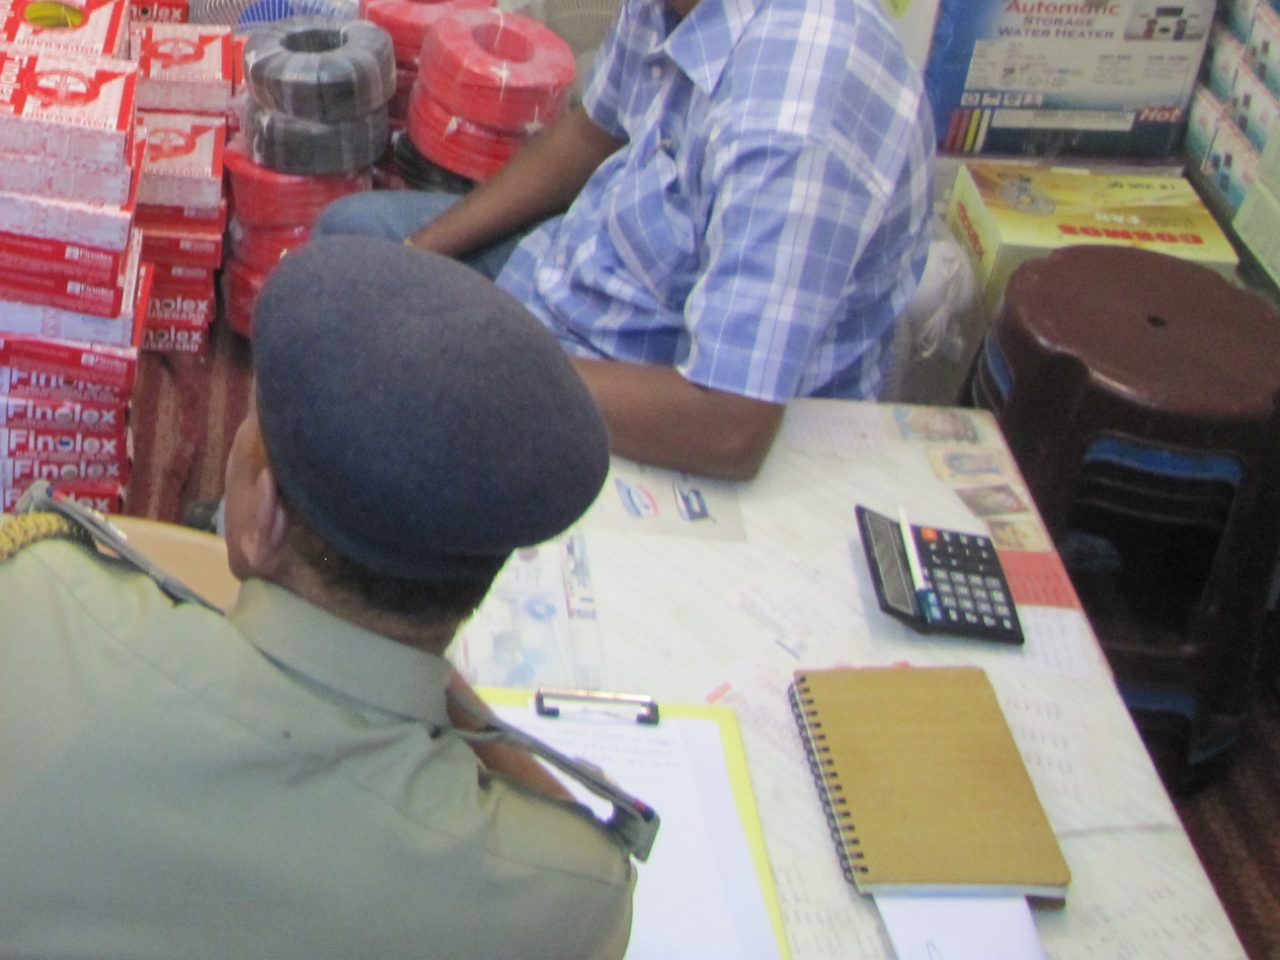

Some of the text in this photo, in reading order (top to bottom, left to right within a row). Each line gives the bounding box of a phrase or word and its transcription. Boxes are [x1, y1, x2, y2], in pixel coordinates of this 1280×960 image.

[149, 296, 208, 313] nolex
[143, 325, 202, 343] nolex
[8, 398, 117, 425] Finolex
[9, 428, 117, 454] Finolex
[14, 458, 120, 481] Finolex
